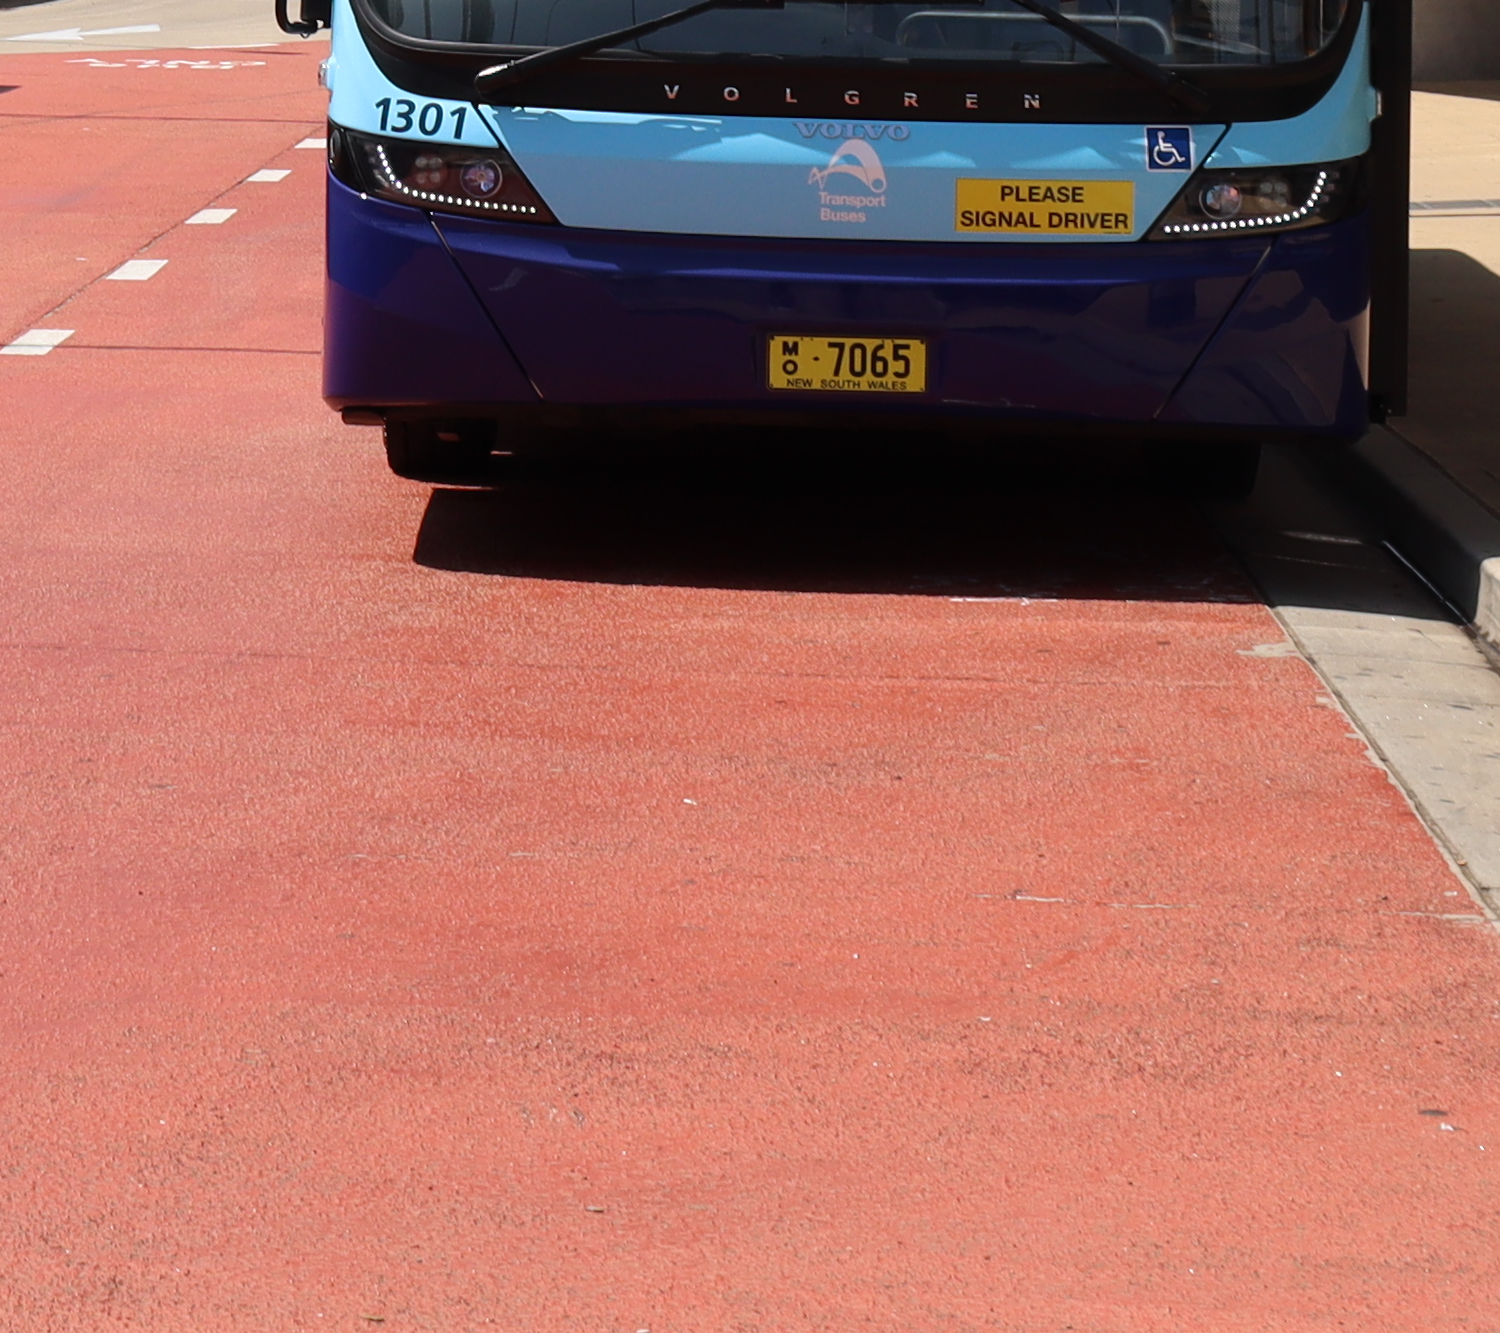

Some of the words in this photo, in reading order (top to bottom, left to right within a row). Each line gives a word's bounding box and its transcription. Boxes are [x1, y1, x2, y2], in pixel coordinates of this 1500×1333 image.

[664, 84, 1041, 110] VOLGREN
[375, 97, 467, 140] 1301
[792, 121, 912, 141] VOLVO
[818, 191, 887, 208] Transport
[1001, 185, 1084, 203] PLEASE
[820, 207, 867, 223] Buses
[960, 210, 1041, 228] SIGNAL
[1048, 212, 1128, 229] DRIVER
[827, 342, 911, 378] 7065
[786, 378, 814, 388] NEW
[820, 379, 861, 389] SOUTH
[867, 380, 907, 390] WALES
